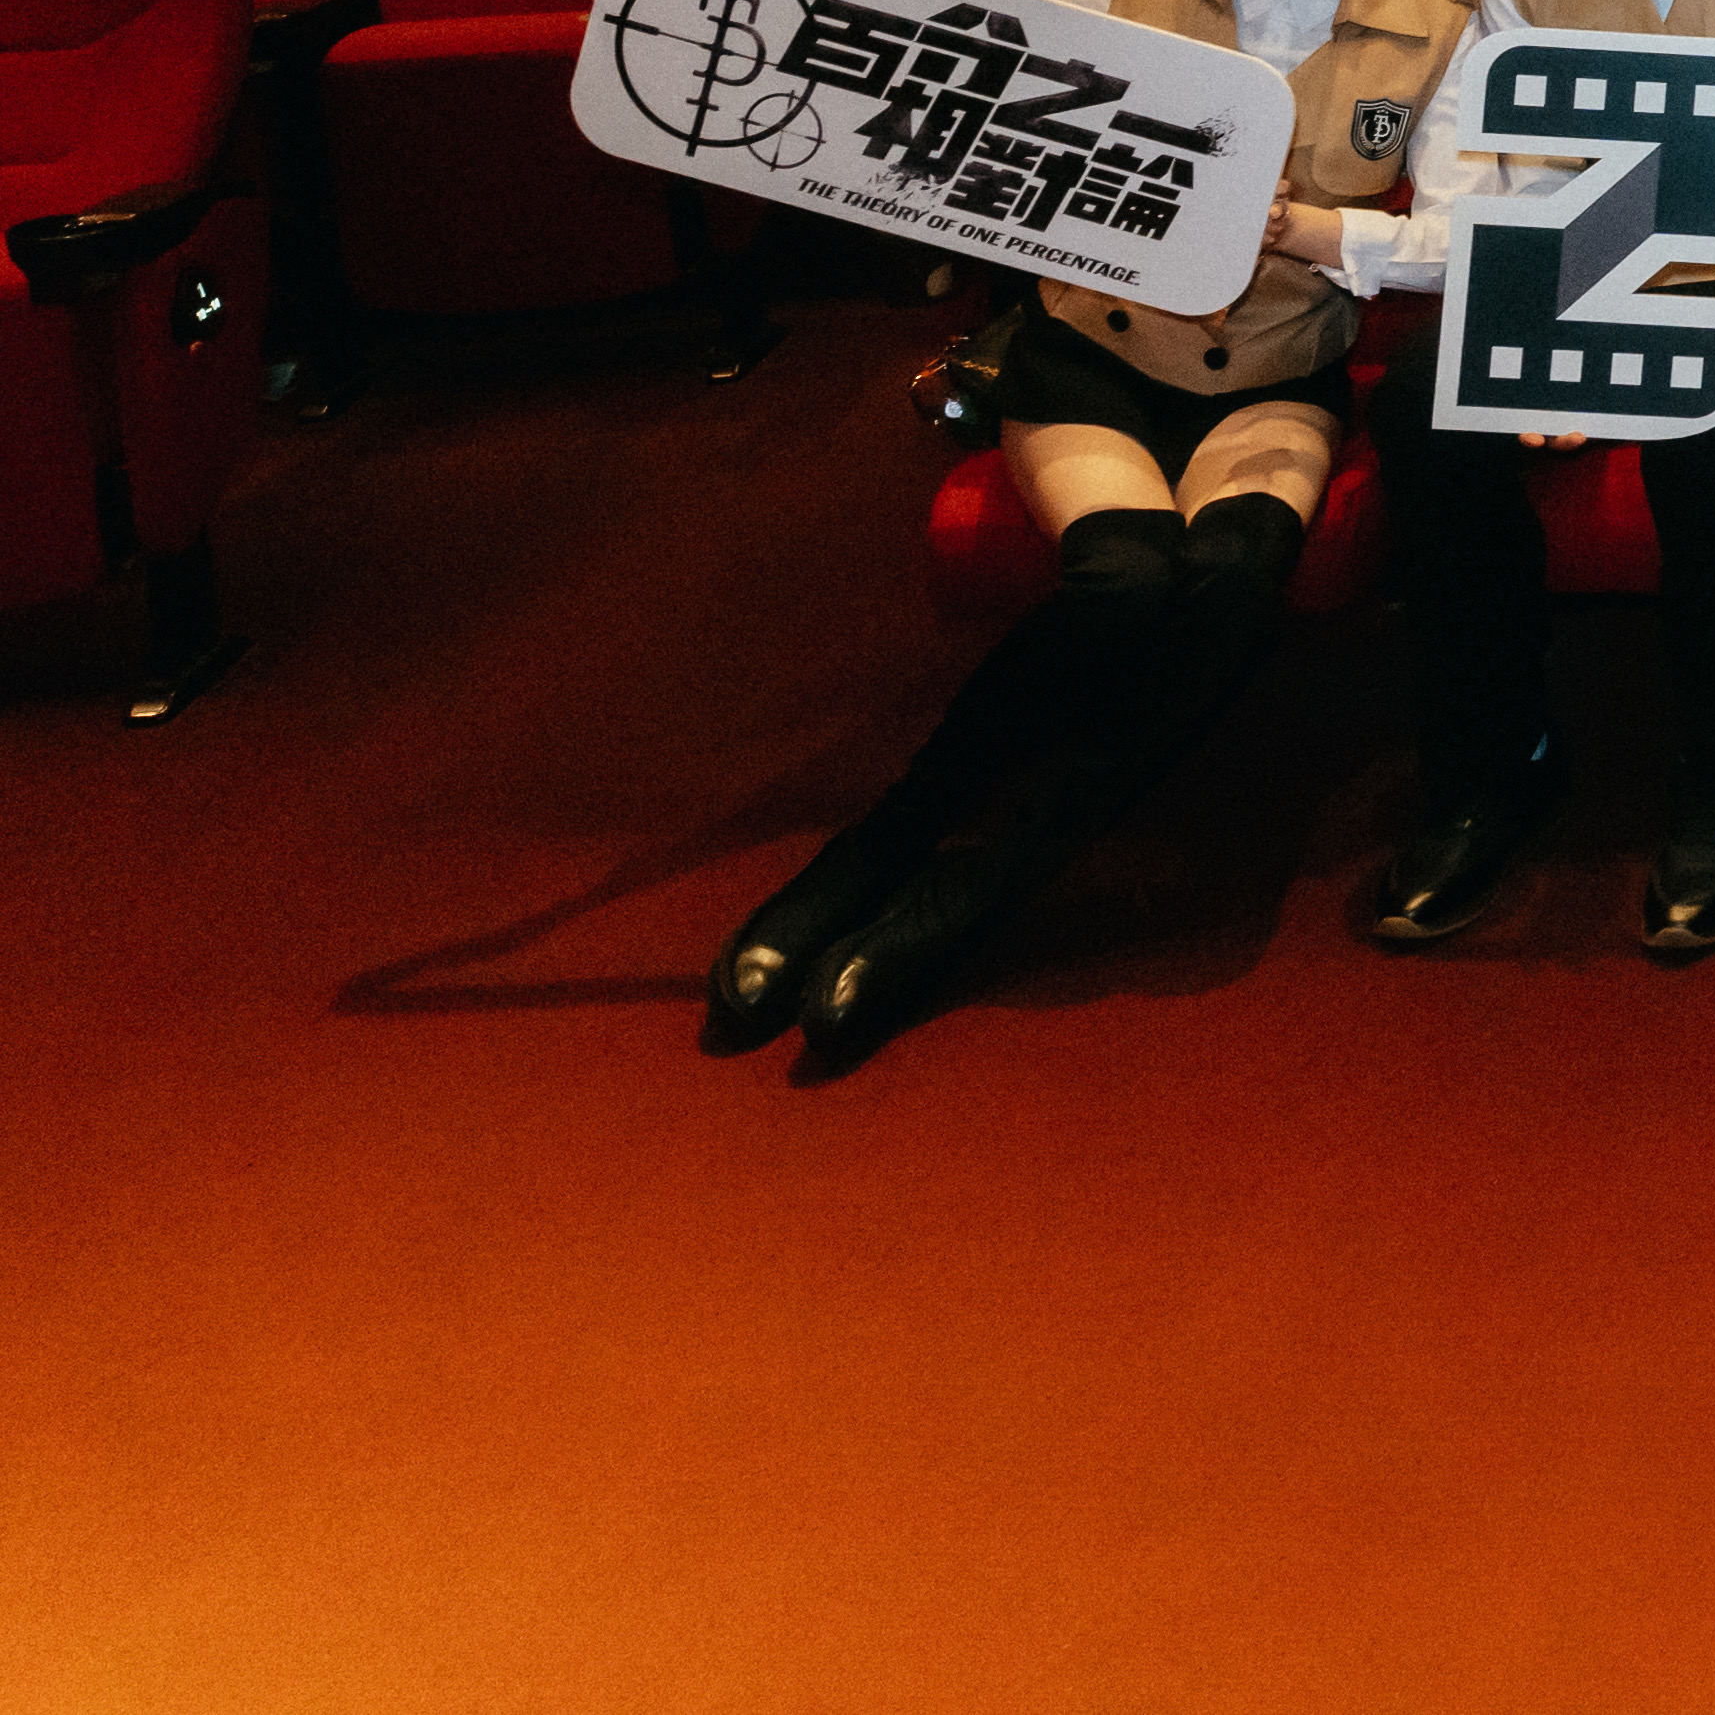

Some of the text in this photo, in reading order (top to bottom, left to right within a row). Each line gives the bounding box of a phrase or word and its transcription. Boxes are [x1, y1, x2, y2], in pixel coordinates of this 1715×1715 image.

[854, 80, 1195, 241] 相對論
[797, 177, 1141, 286] THE THEORY OF ONE PERCENTAGE.
